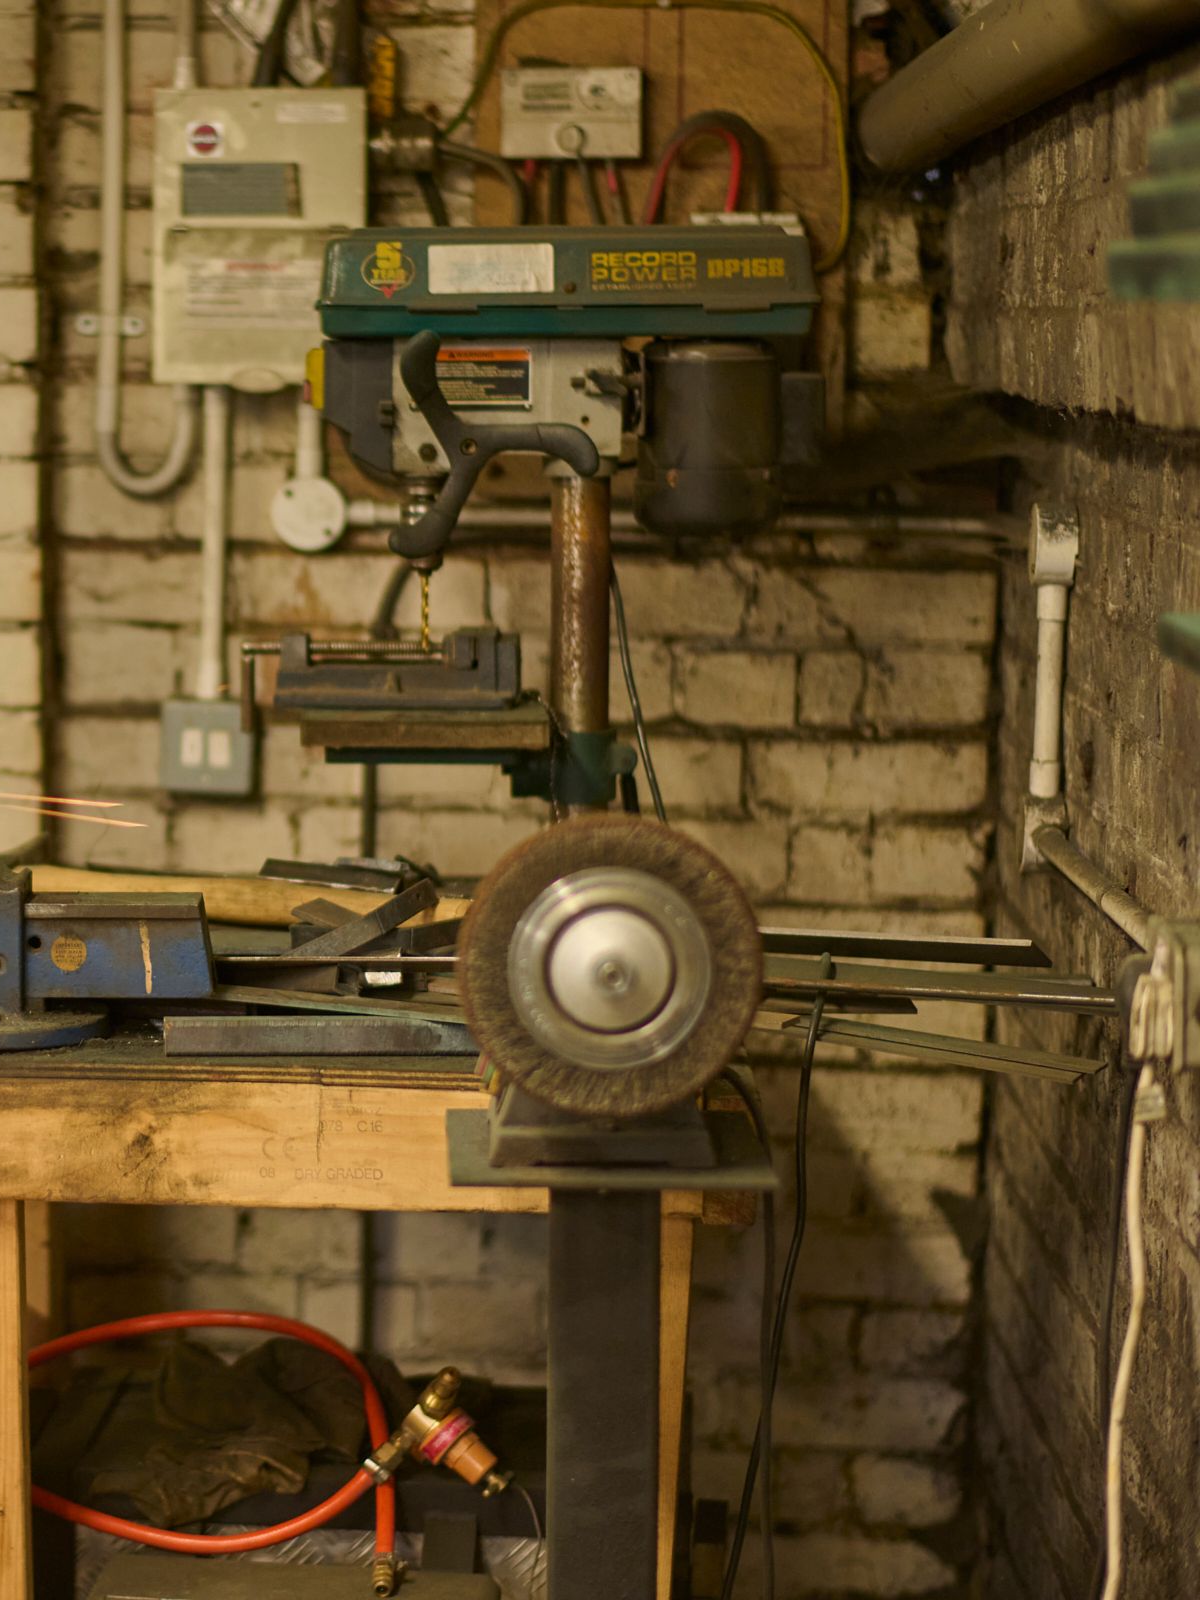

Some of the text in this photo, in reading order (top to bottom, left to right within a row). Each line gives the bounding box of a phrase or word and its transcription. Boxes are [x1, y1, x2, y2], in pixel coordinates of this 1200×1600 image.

[376, 241, 402, 269] 5
[591, 252, 697, 267] RECORD
[591, 267, 697, 283] POWER
[294, 1167, 321, 1181] DRY
[325, 1167, 384, 1181] GRADED
